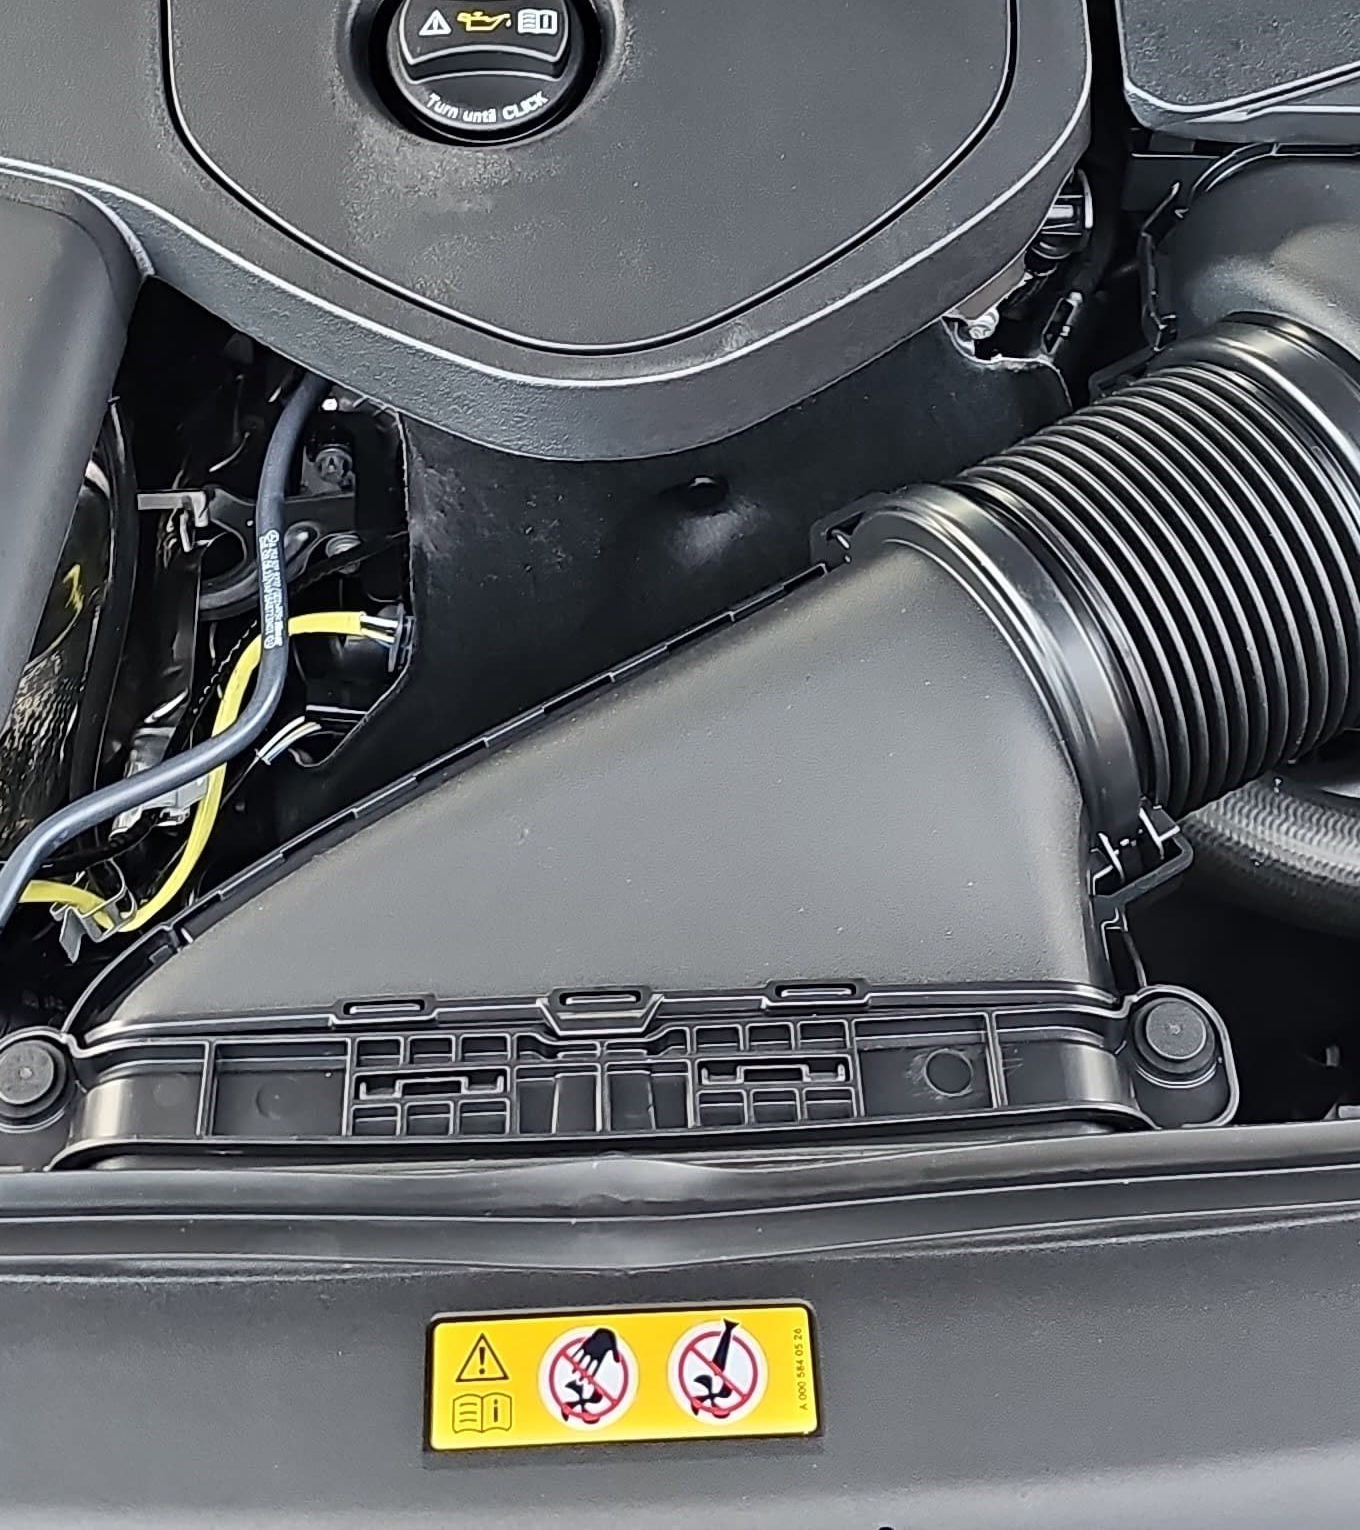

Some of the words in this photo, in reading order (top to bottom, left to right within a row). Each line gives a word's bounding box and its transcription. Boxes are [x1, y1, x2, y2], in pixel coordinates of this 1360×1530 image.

[427, 92, 459, 119] Turn
[462, 108, 497, 123] until
[502, 90, 549, 120] CLICK
[793, 1328, 803, 1340] 26
[794, 1343, 804, 1356] 05
[796, 1360, 805, 1378] 584
[797, 1381, 807, 1400] 000
